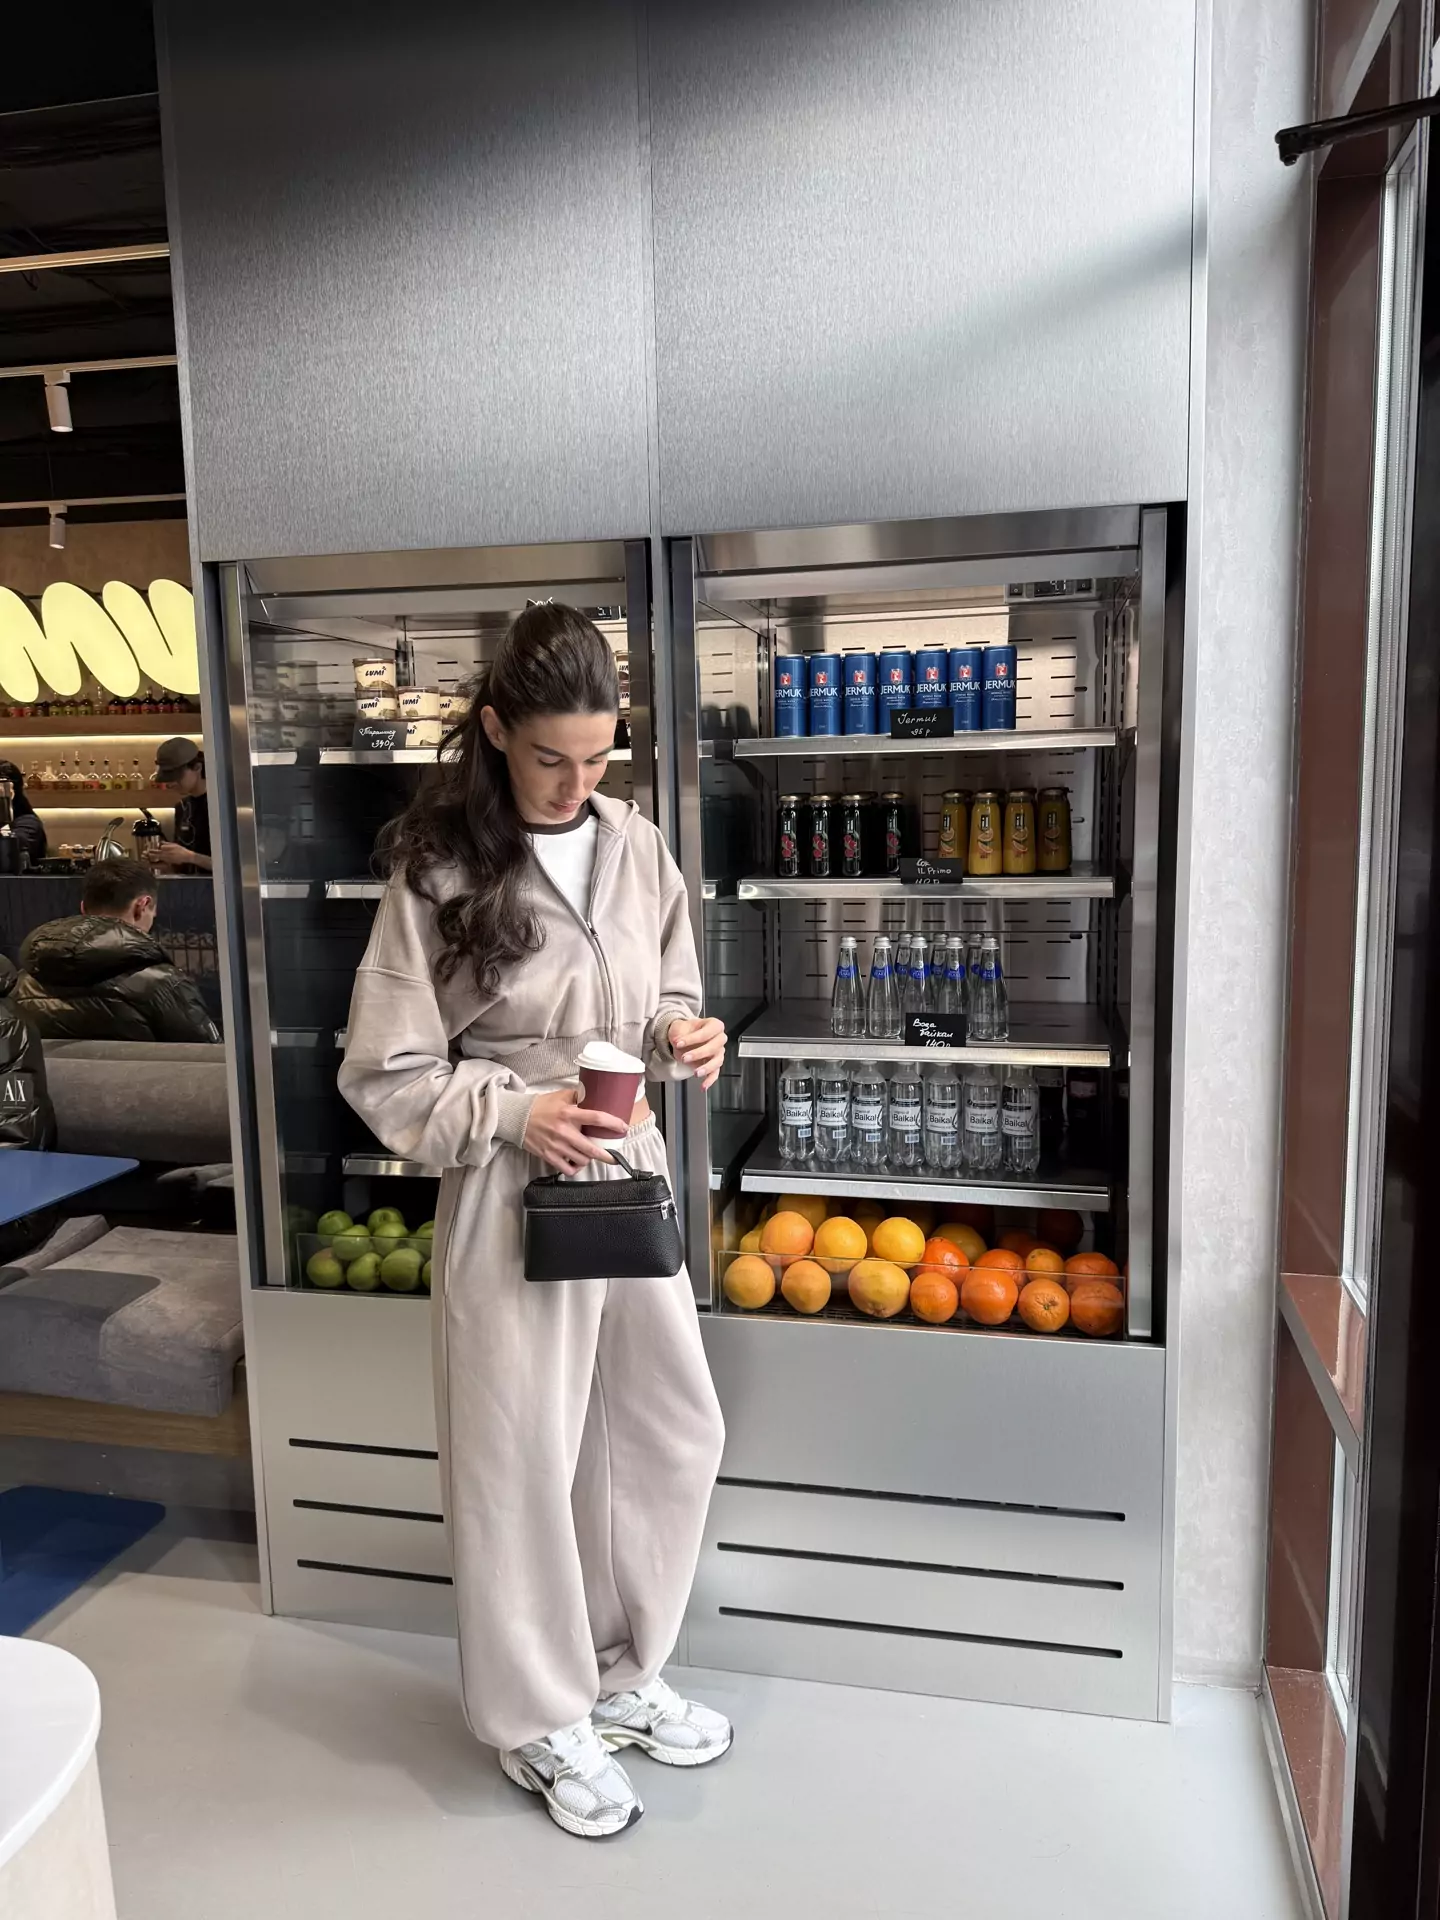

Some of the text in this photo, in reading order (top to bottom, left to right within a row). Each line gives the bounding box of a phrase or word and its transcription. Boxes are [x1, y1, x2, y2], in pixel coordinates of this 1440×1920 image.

[880, 684, 910, 695] JERMUK
[916, 683, 946, 694] JERMUK
[950, 681, 980, 692] JERMUK
[984, 679, 1016, 691] JERMUK
[775, 688, 802, 698] ERMUK
[810, 687, 838, 697] ERMUK
[845, 686, 875, 697] JERMUK
[927, 866, 952, 875] Primo
[786, 1109, 808, 1117] Baikal
[820, 1110, 843, 1118] Baikal
[855, 1112, 877, 1121] Baikal
[893, 1113, 916, 1122] Baikal
[930, 1114, 952, 1123] Baikal
[970, 1115, 993, 1124] Baikal
[1004, 1117, 1028, 1127] Baikal
